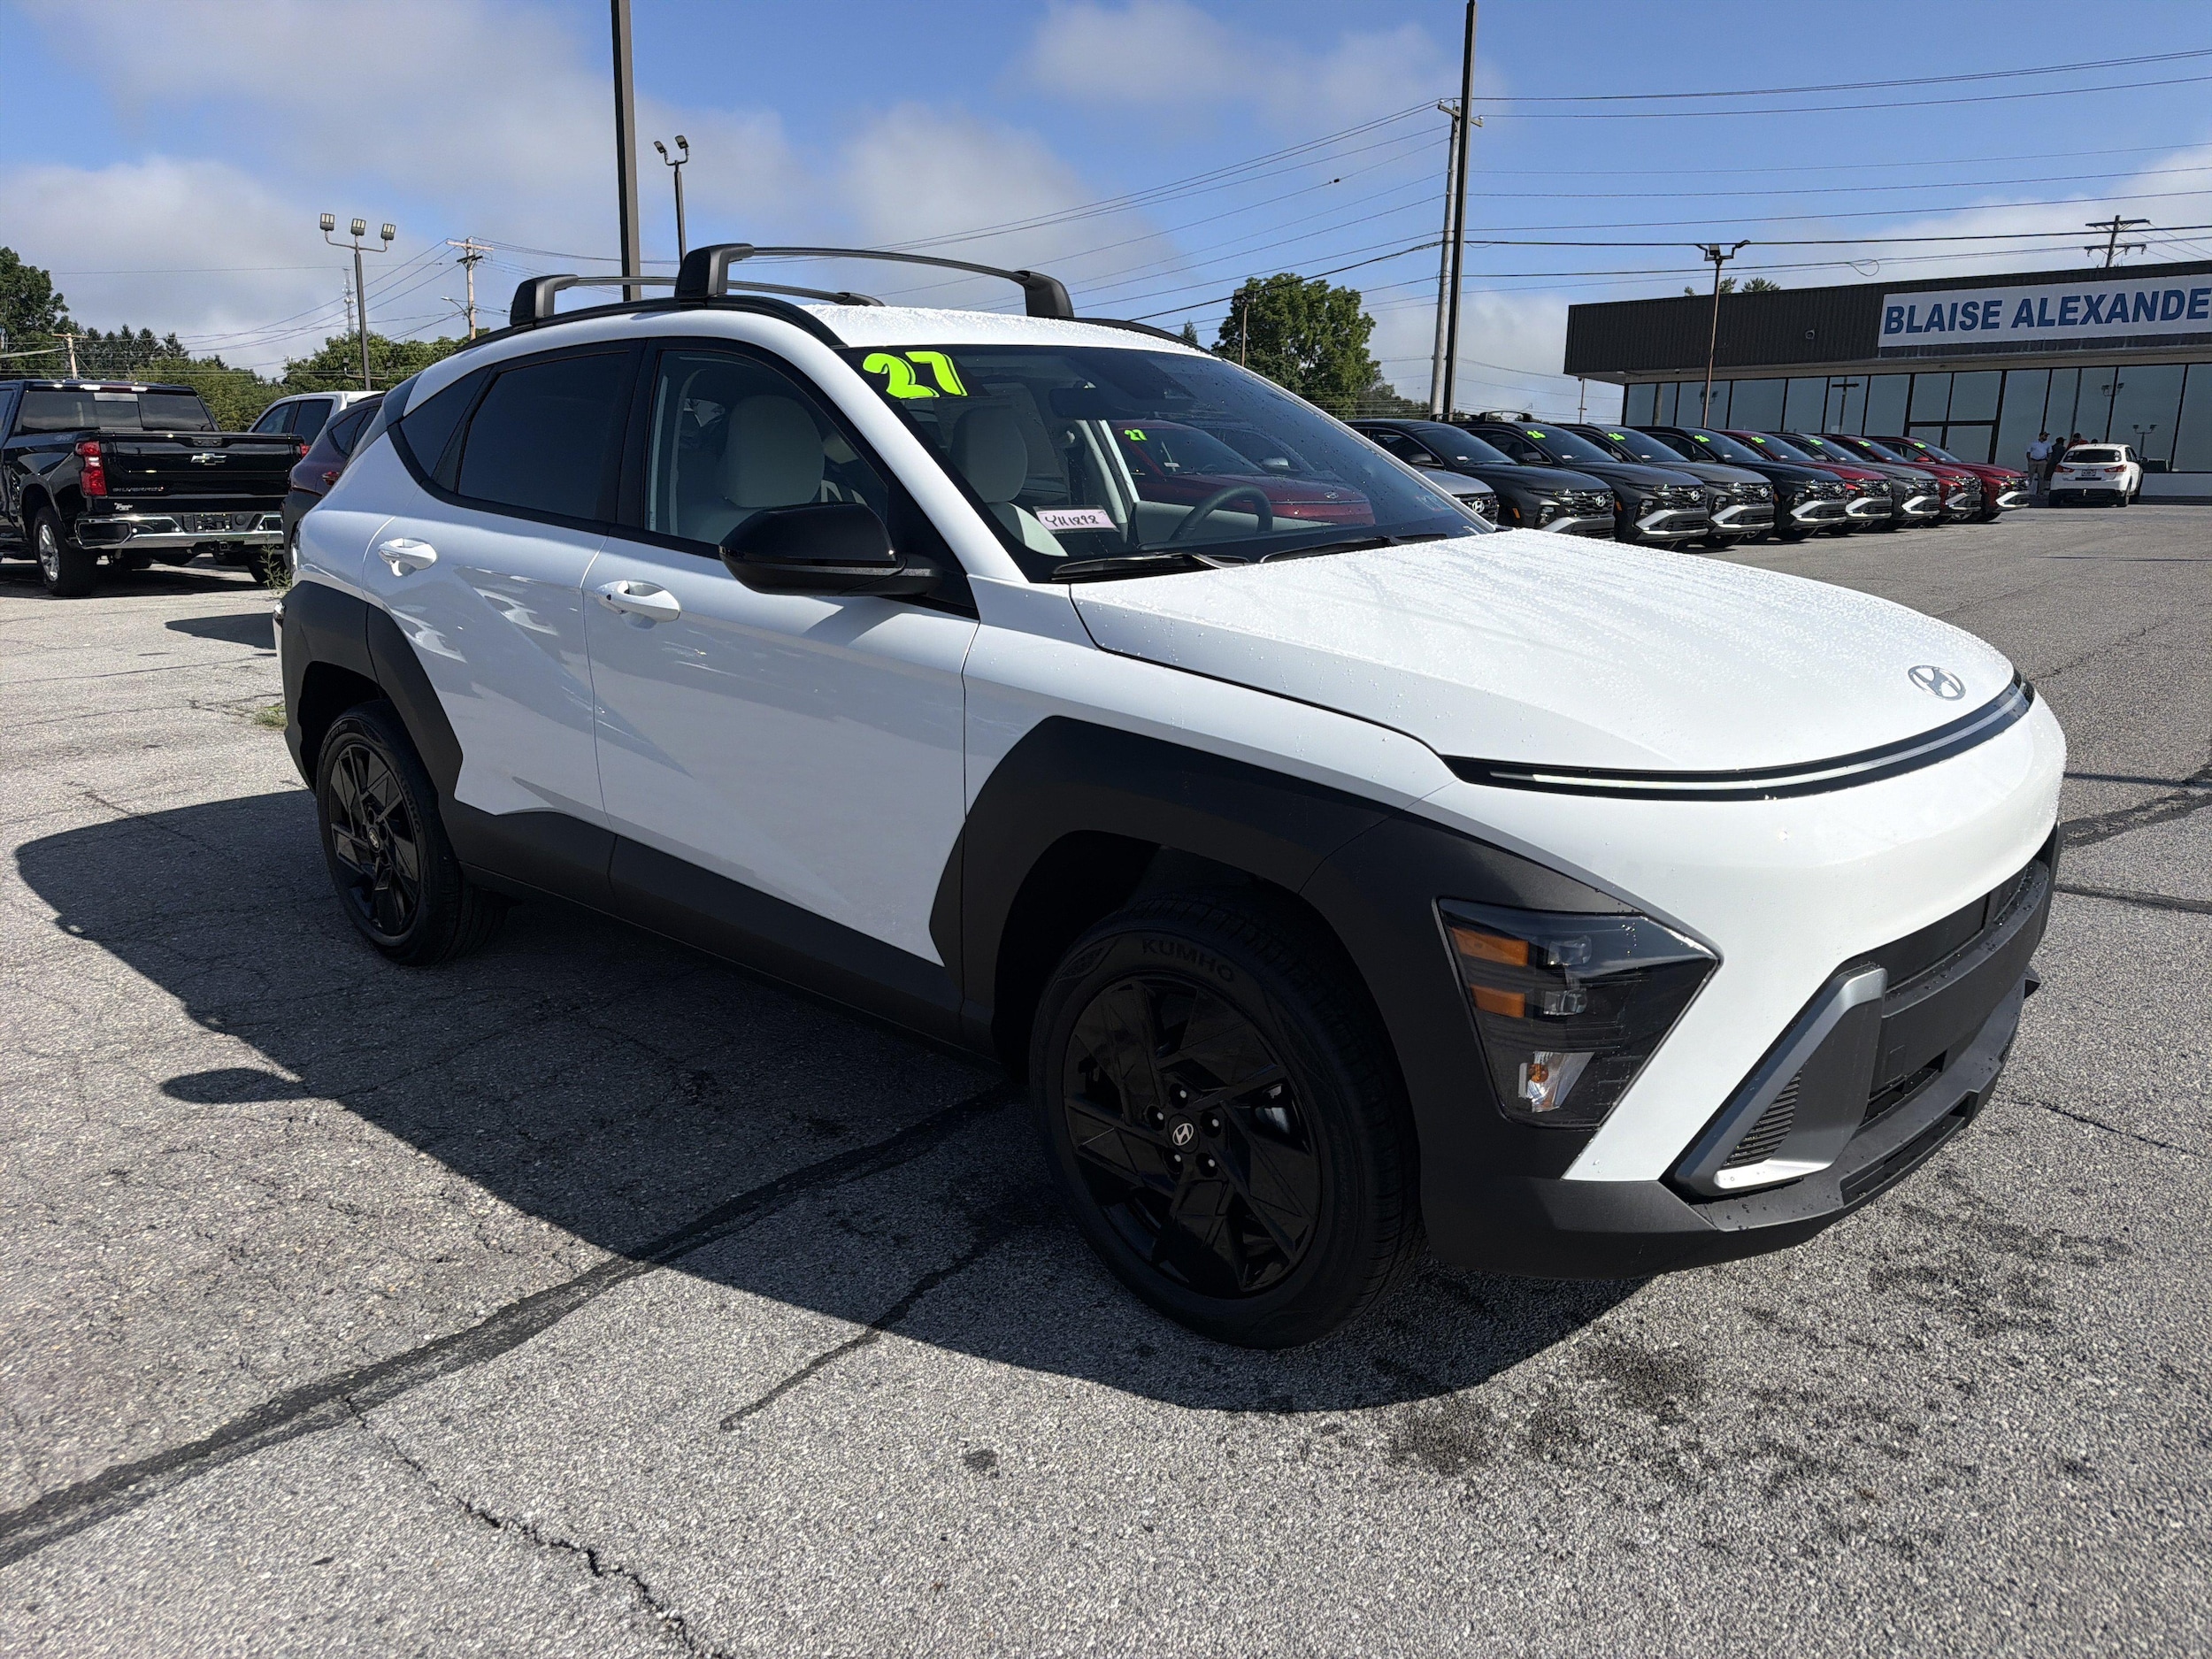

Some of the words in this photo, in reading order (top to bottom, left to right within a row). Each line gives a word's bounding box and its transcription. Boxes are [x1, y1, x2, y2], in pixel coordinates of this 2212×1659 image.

[1883, 300, 2003, 335] BLAISE
[2010, 288, 2212, 328] ALEXANDE
[863, 351, 968, 399] 27
[1124, 428, 1148, 441] 27
[1142, 937, 1234, 983] KUMHO
